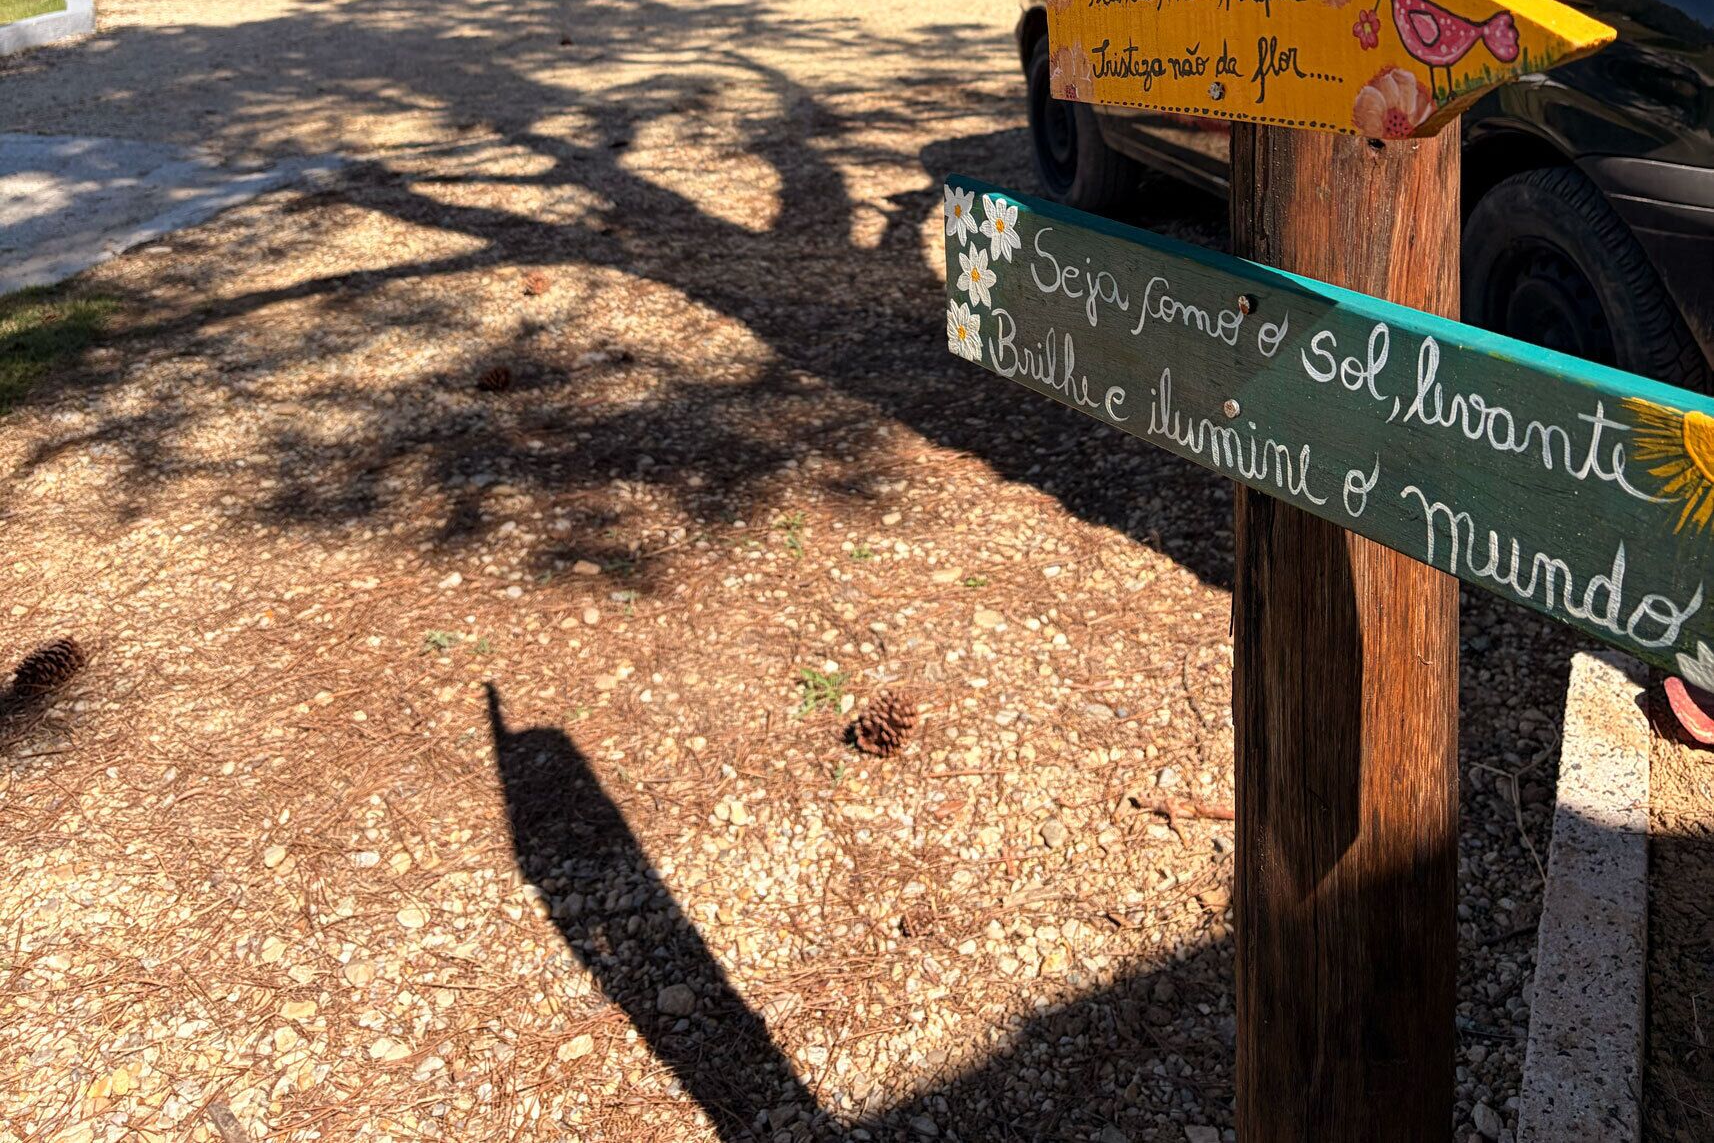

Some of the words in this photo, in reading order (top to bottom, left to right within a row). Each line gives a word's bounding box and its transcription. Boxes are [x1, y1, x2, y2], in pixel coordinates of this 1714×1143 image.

[1092, 37, 1166, 91] Tristeza
[1168, 41, 1210, 80] não
[1215, 38, 1244, 78] da
[988, 308, 1101, 408] Brilhe
[1105, 385, 1131, 422] e
[1147, 367, 1330, 505] ilumine
[1343, 452, 1379, 517] o
[1030, 228, 1130, 327] Seja
[1258, 309, 1289, 358] o
[1404, 336, 1684, 504] levante
